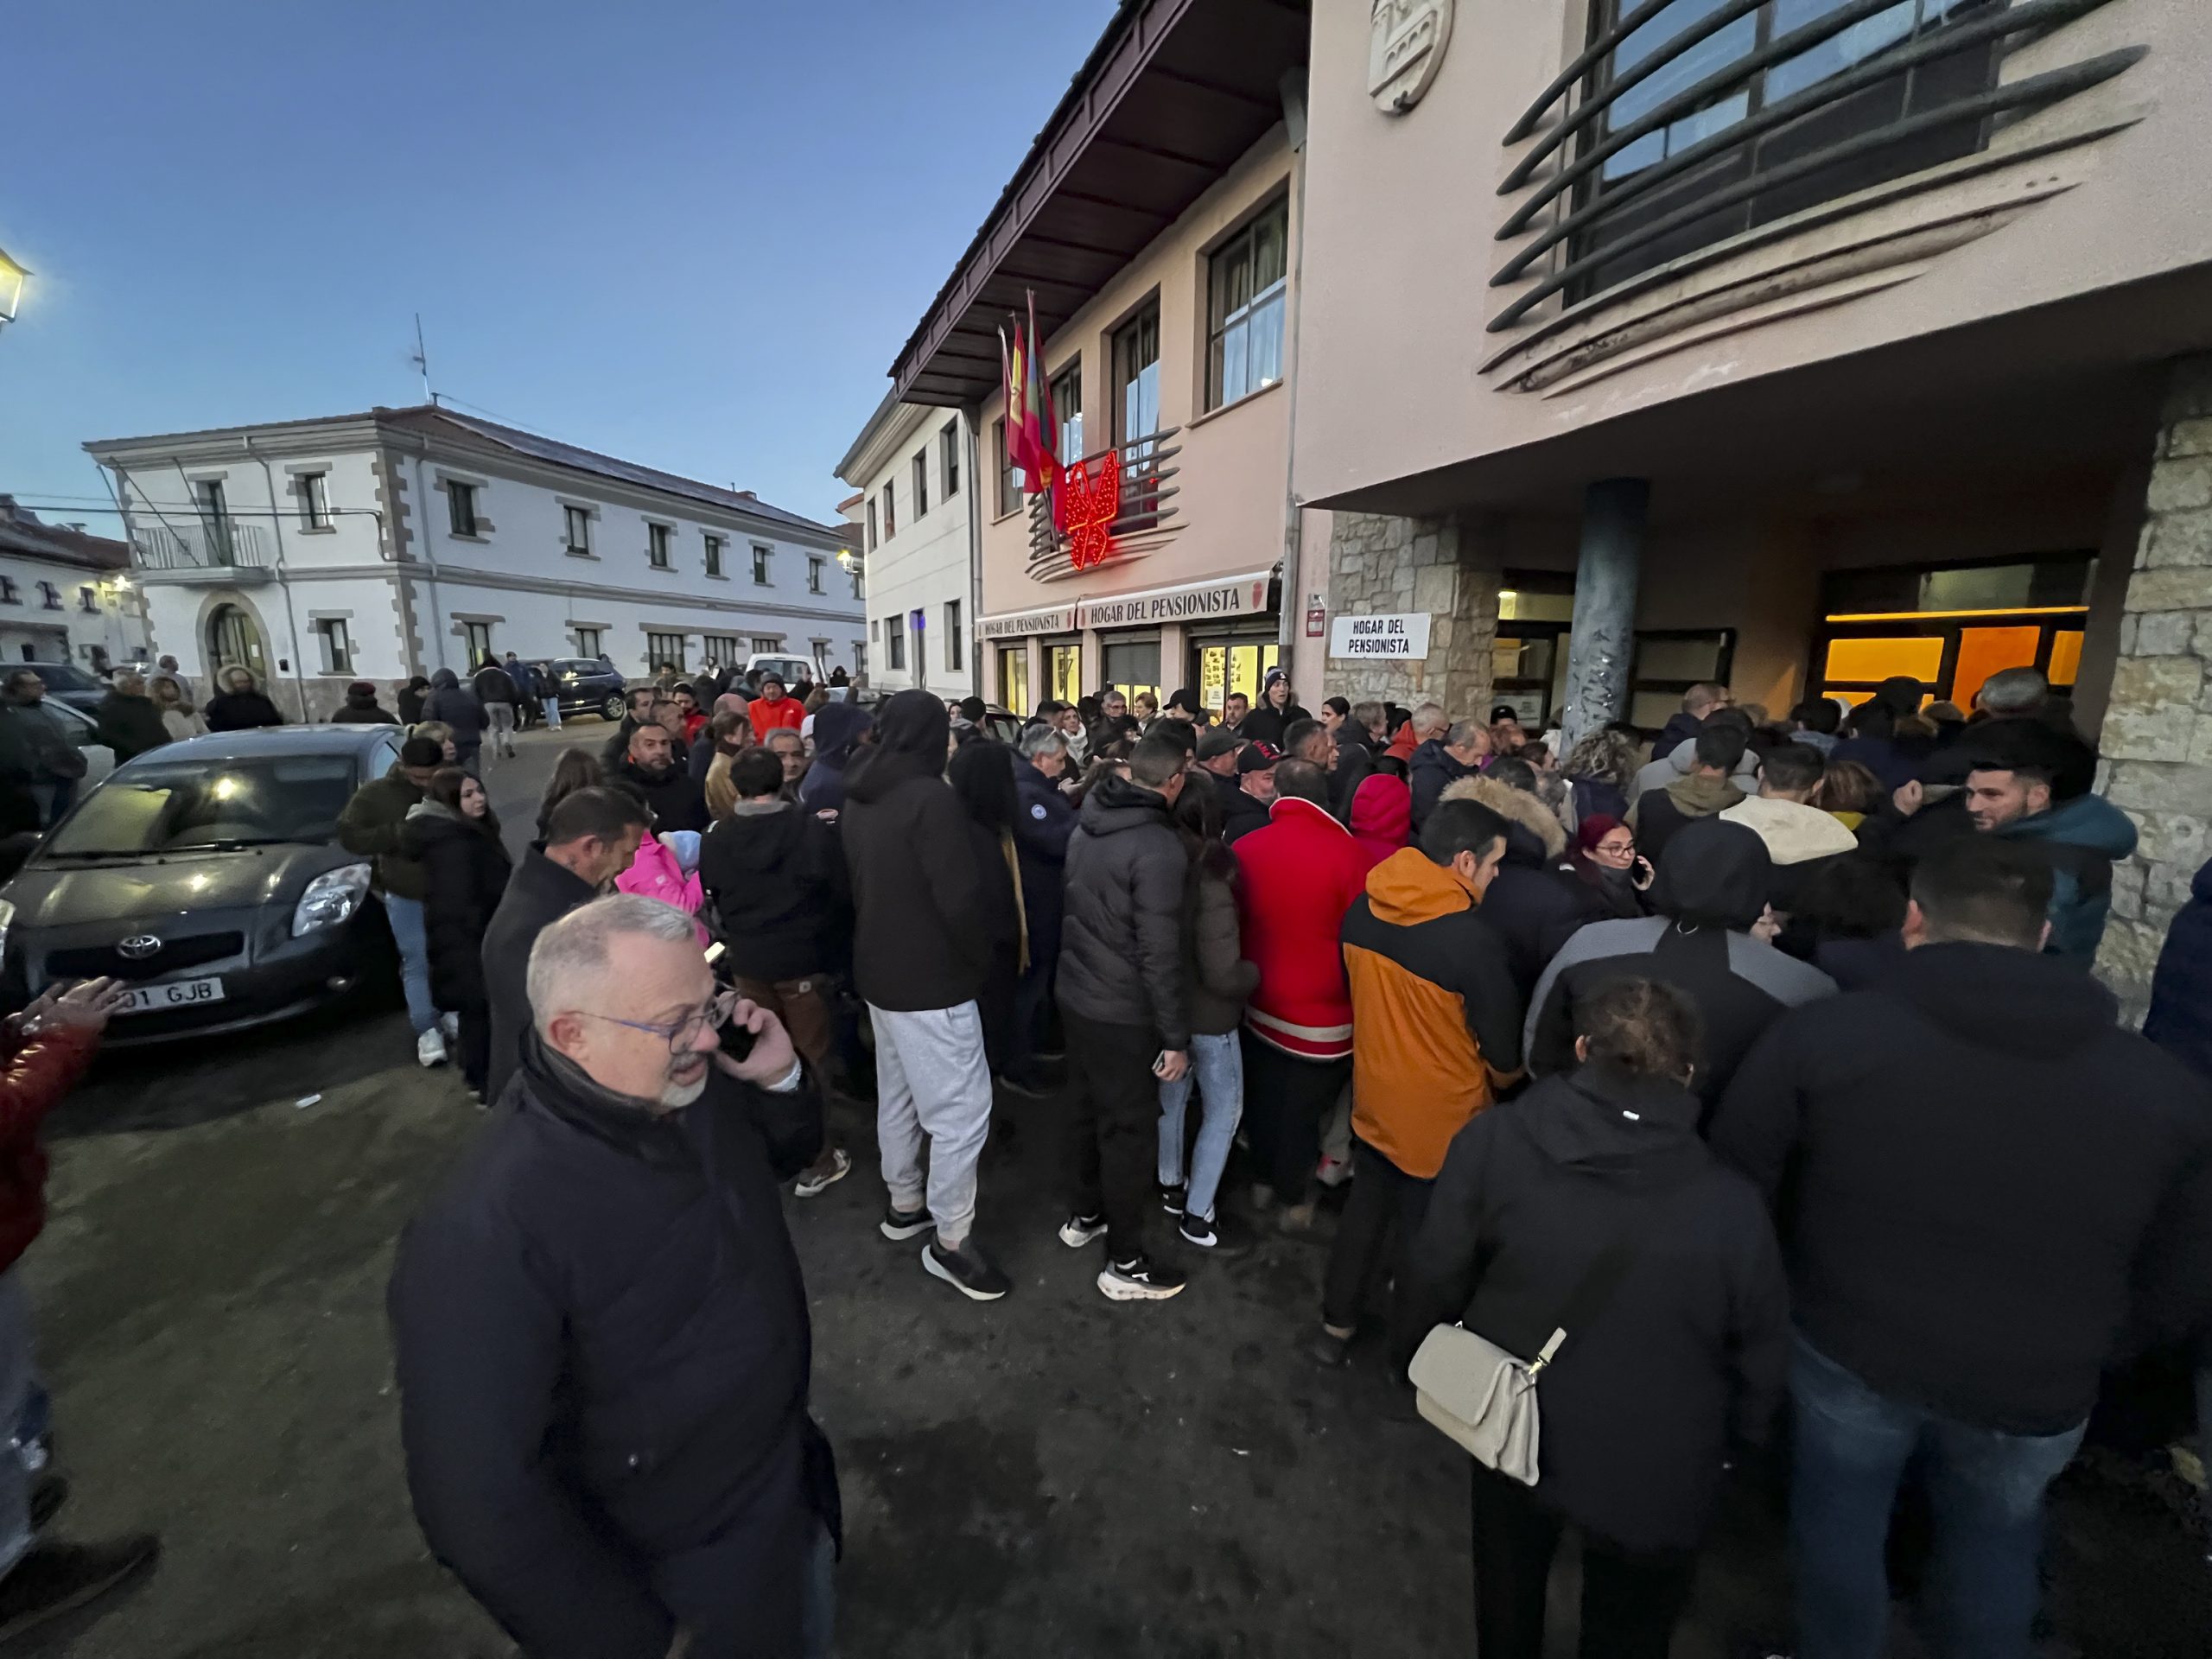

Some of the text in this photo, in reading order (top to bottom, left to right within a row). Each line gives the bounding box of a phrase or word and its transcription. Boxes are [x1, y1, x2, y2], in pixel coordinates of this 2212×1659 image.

[1090, 588, 1240, 625] HOGAR DEL PENSIONISTA
[985, 613, 1059, 636] HOGAR DEL PENSIONISTA
[1353, 619, 1405, 634] HOGAR DEL
[1348, 639, 1409, 654] PENSIONISTA
[167, 982, 213, 1002] GJB
